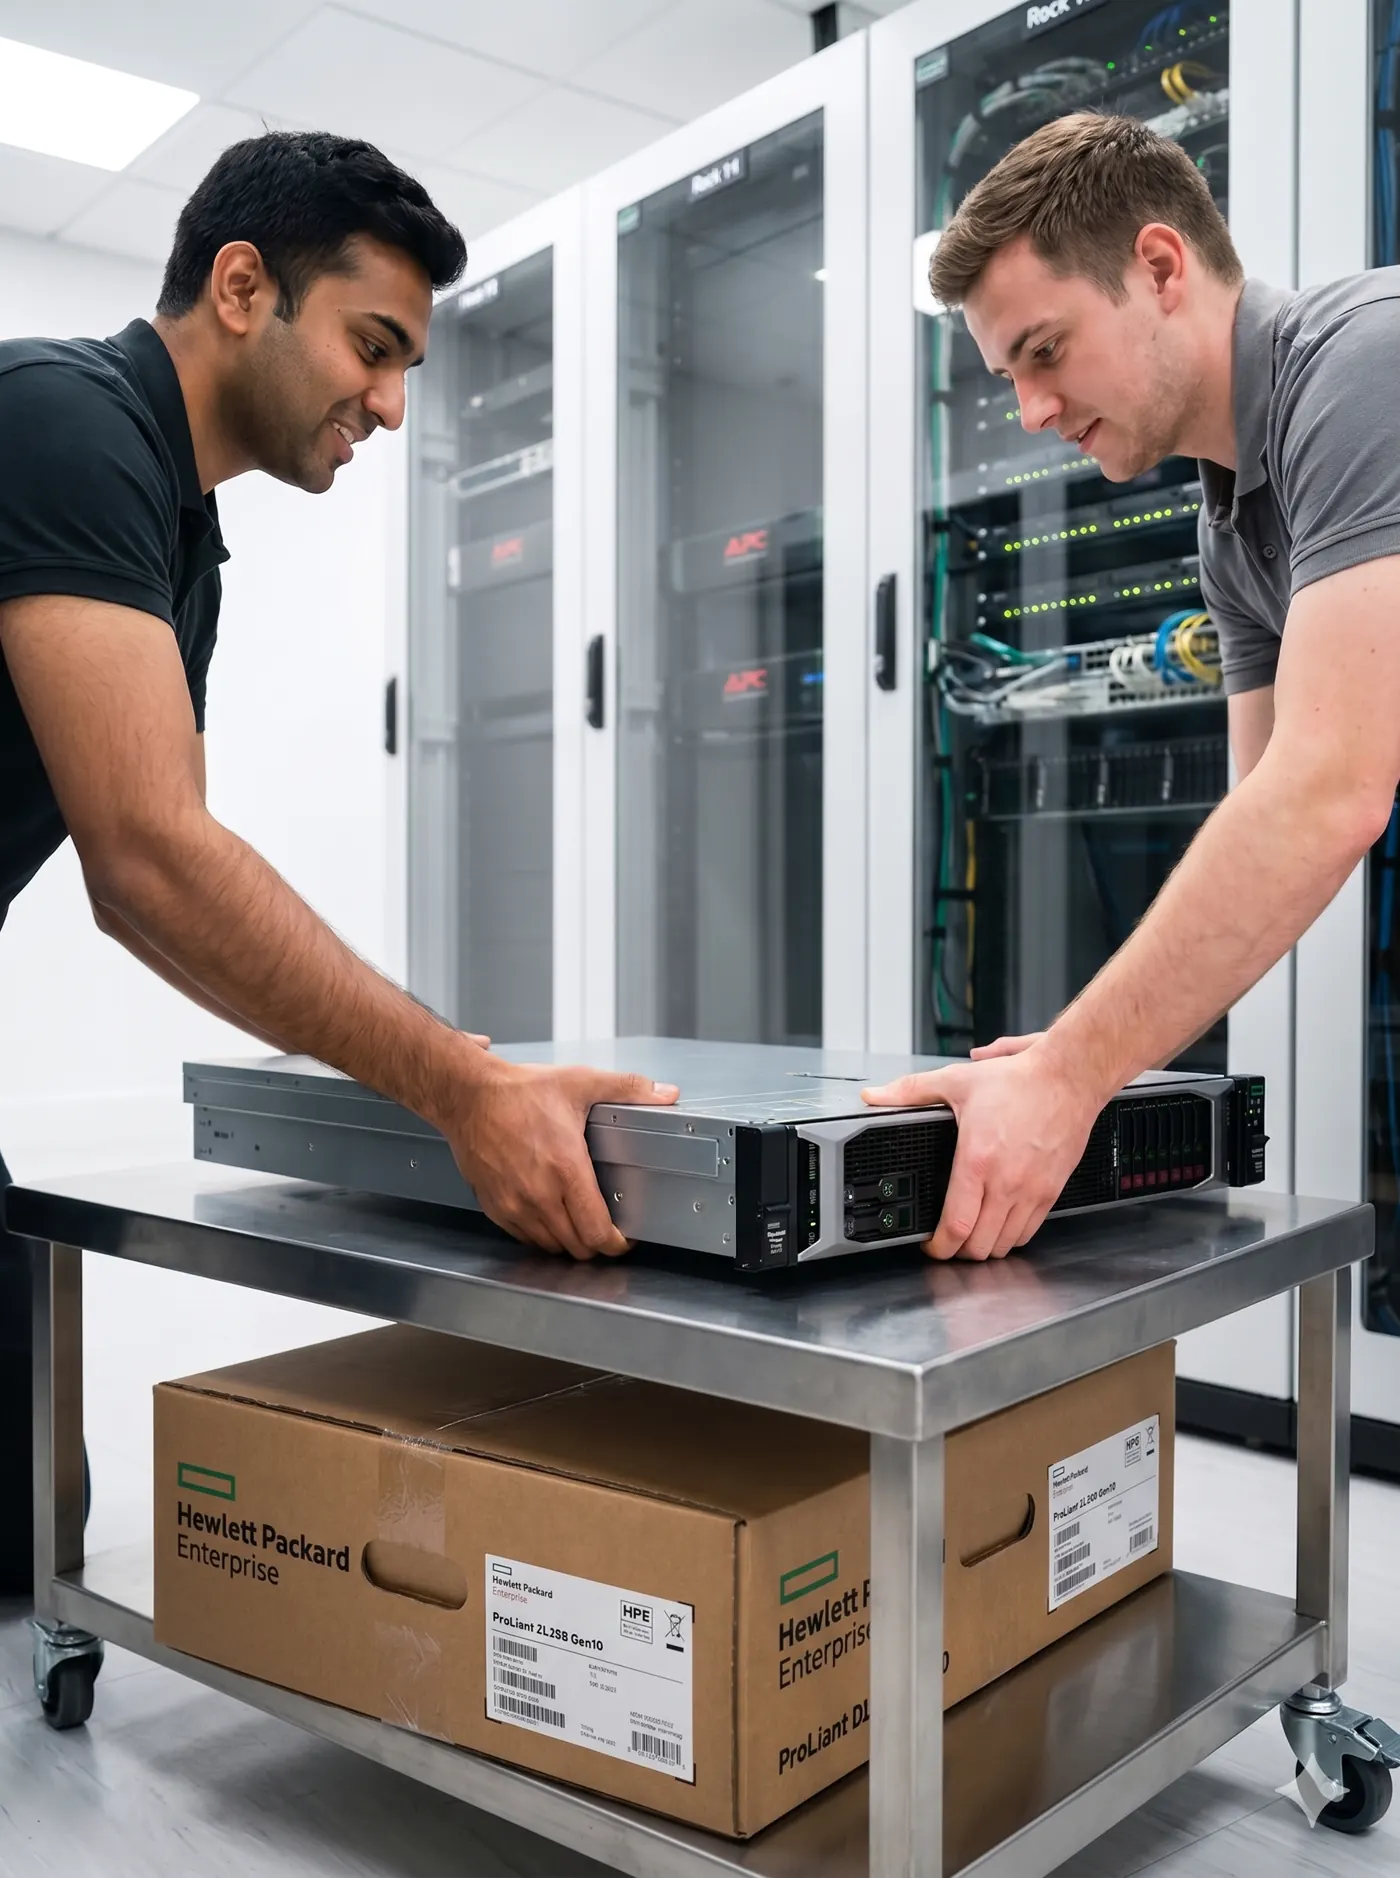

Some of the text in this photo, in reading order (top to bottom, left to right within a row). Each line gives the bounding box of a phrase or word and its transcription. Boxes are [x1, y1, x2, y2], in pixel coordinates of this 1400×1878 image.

[177, 1501, 350, 1573] Hewlett Packard
[177, 1533, 279, 1586] Enterprise
[492, 1575, 553, 1599] Hewlett Packard
[492, 1586, 528, 1604] Enterprise
[492, 1611, 535, 1633] ProLiant
[570, 1633, 604, 1651] Gen10
[623, 1604, 650, 1623] HPE
[779, 1588, 858, 1652] Hewlett
[779, 1713, 848, 1776] ProLiant
